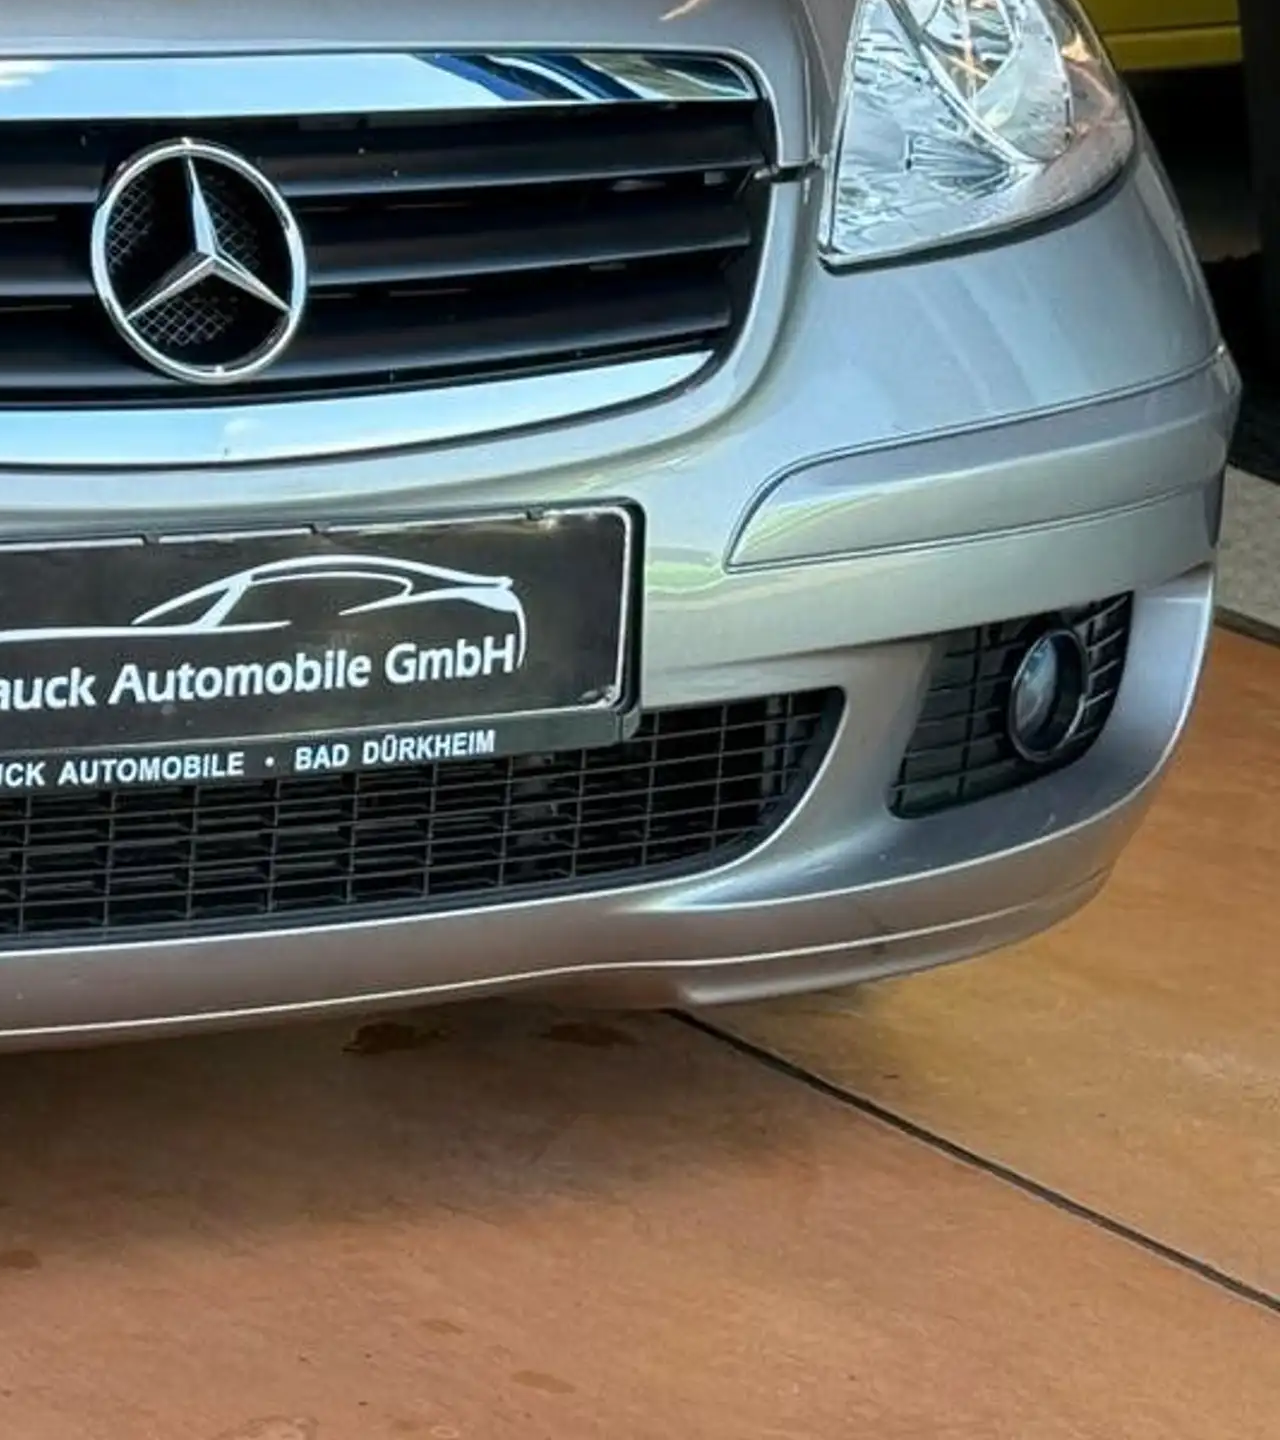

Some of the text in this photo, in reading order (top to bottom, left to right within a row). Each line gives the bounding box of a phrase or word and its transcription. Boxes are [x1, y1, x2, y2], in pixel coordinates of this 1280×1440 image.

[107, 649, 372, 706] Automobile
[384, 633, 516, 684] GmbH
[57, 751, 245, 786] AUTOMOBILE
[294, 743, 350, 772] BAD
[362, 729, 497, 765] DÜRKHEIM
